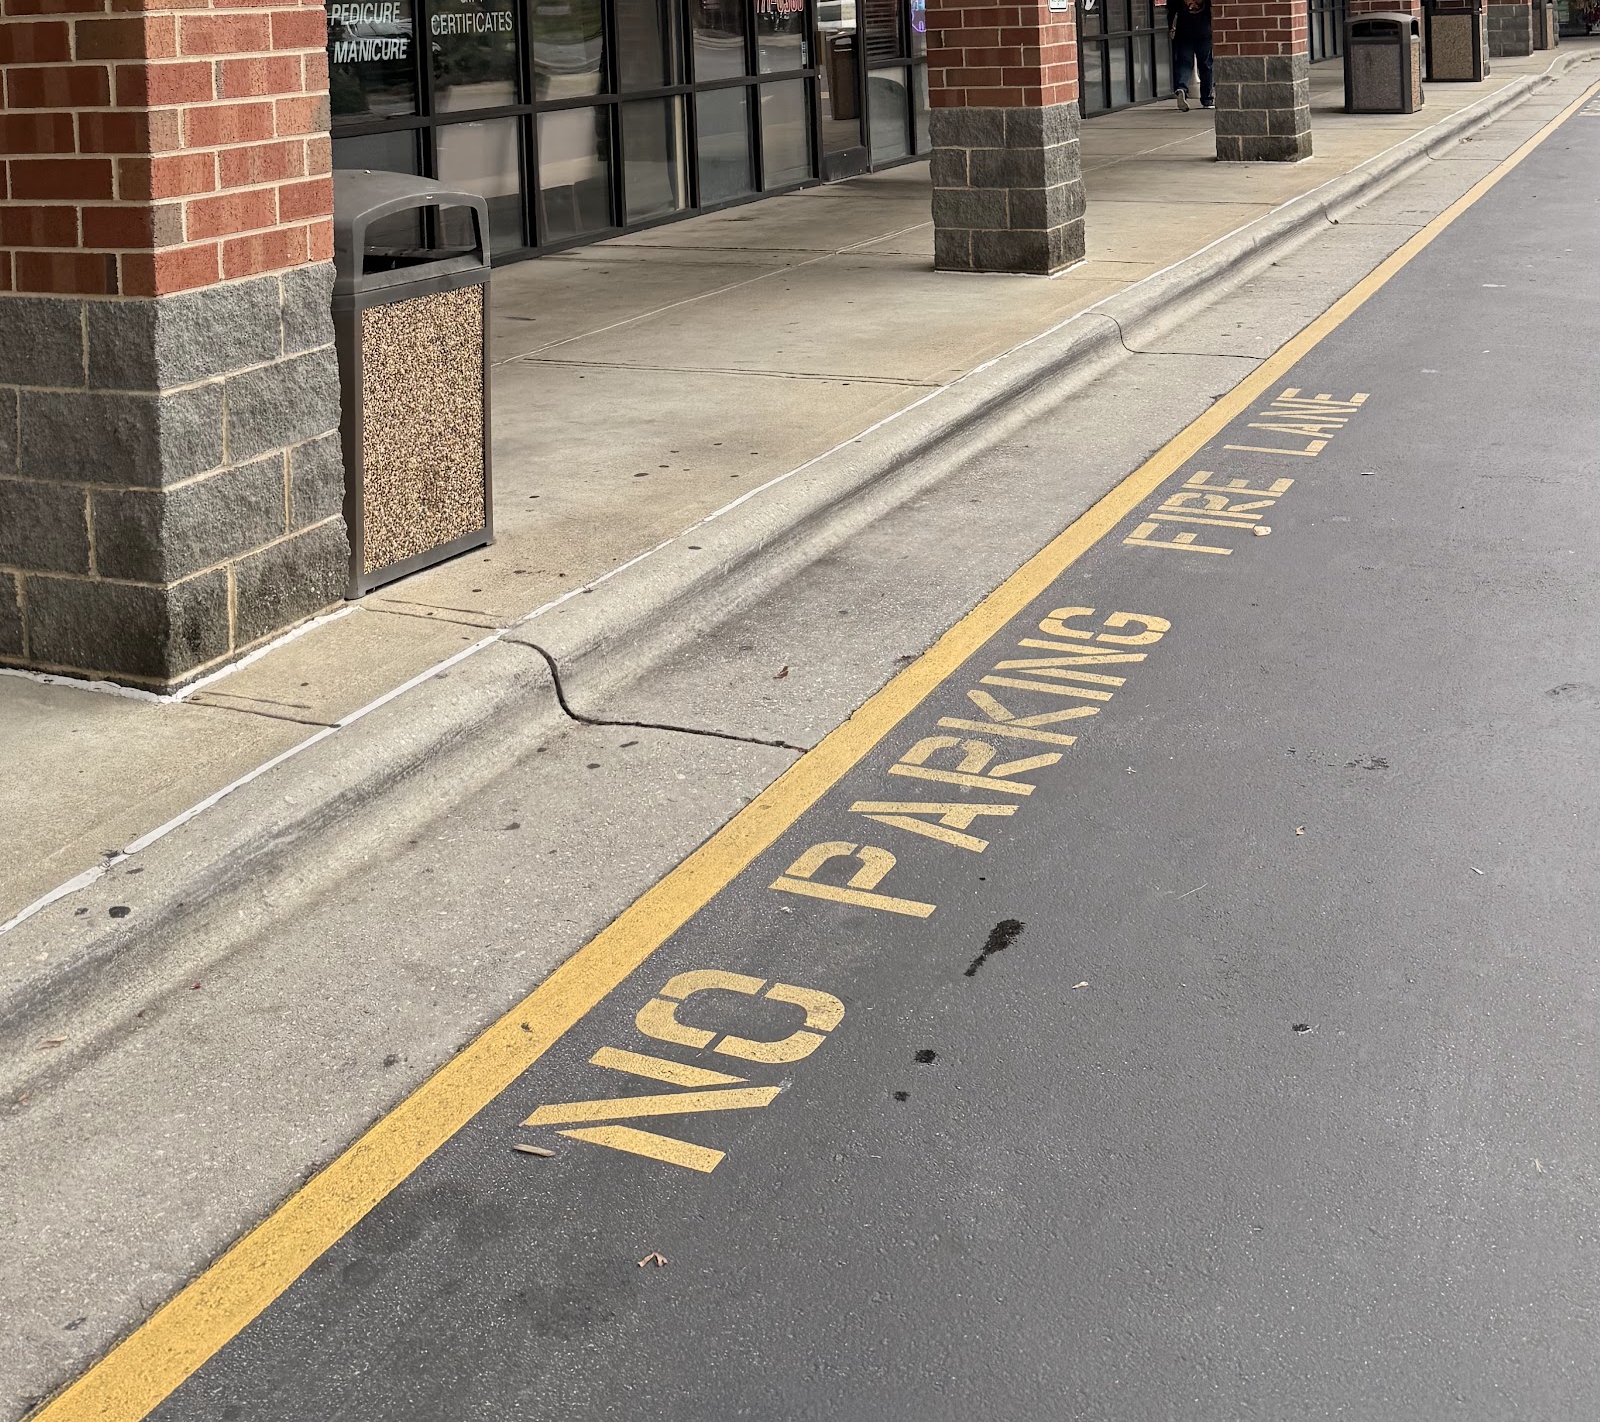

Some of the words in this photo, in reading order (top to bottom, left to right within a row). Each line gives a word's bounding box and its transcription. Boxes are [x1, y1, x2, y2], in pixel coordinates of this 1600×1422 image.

[331, 1, 401, 26] PEDICURE
[431, 11, 513, 36] CERTIFICATES
[333, 38, 408, 64] MANICURE
[519, 968, 847, 1175] NO
[768, 606, 1172, 920] PARKING
[1122, 470, 1295, 556] FIRE
[1222, 387, 1371, 457] LANE
